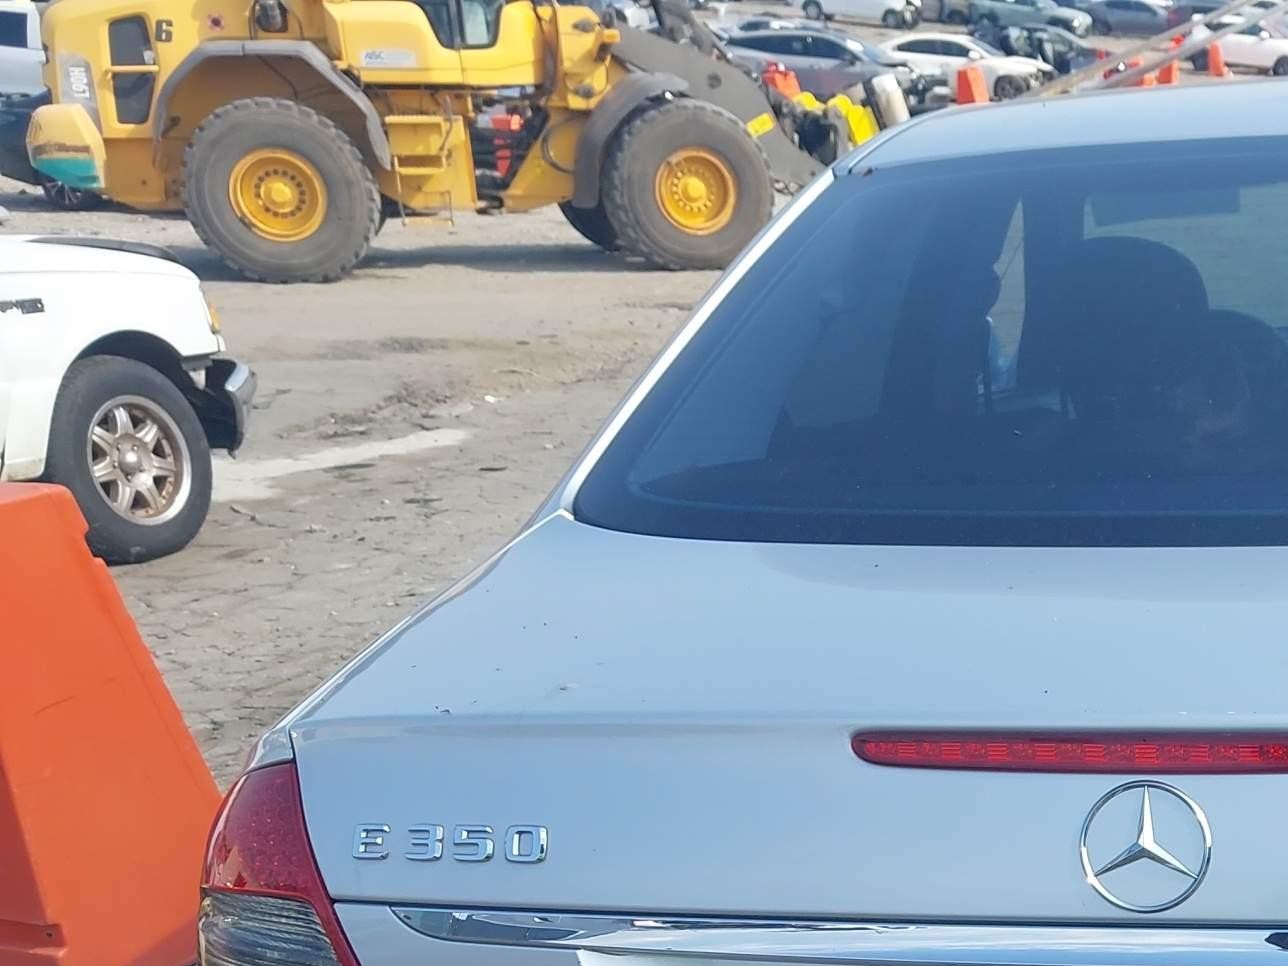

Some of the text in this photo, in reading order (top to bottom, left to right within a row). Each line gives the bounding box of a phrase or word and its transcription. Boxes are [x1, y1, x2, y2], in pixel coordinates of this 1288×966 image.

[154, 19, 173, 42] 6
[351, 823, 549, 864] E 350
